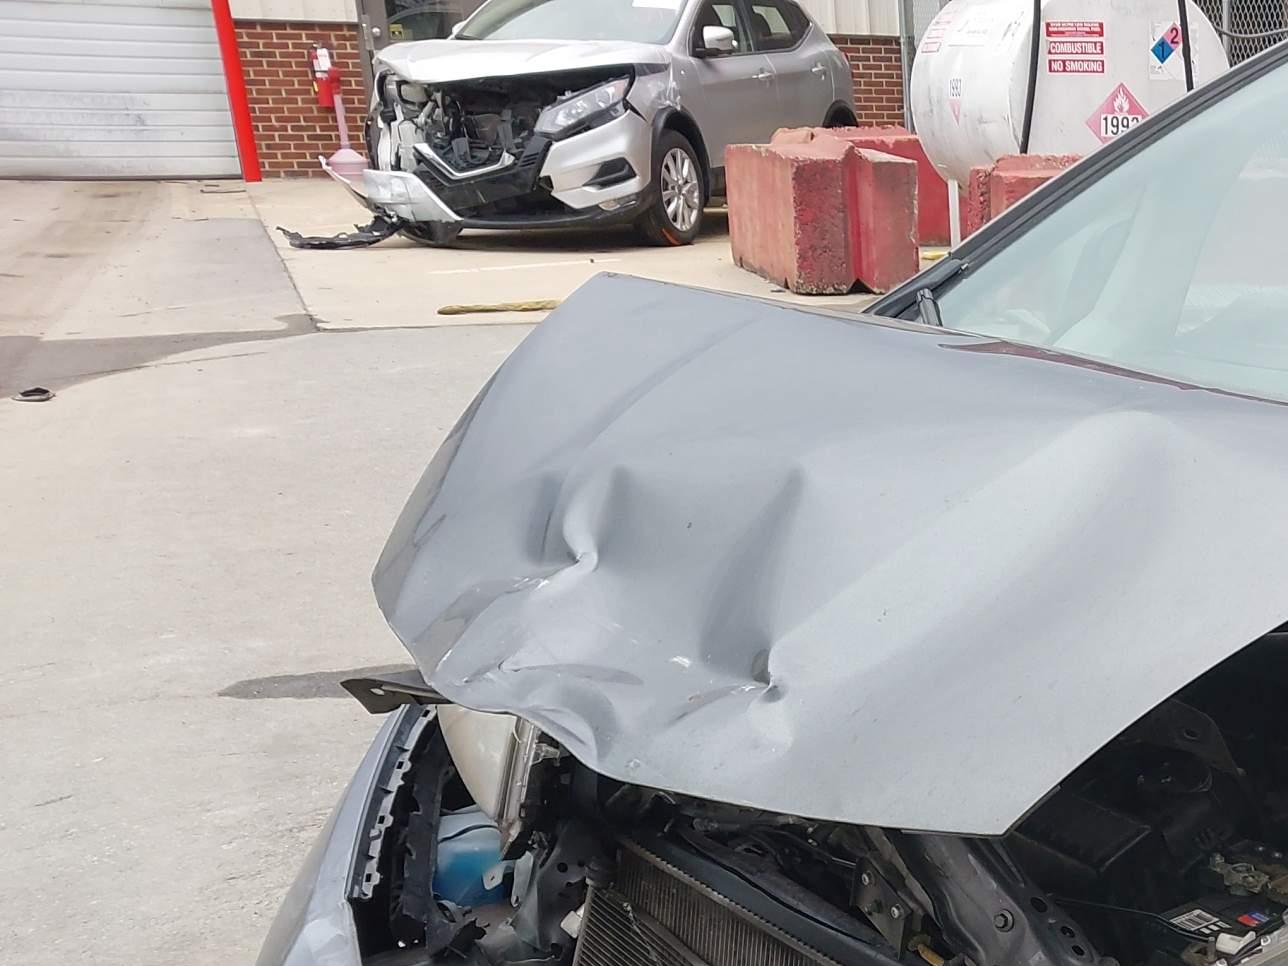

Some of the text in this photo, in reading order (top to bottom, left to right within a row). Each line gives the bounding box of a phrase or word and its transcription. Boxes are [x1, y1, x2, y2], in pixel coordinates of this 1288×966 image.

[1170, 27, 1179, 44] 2
[1049, 43, 1102, 54] COMBUSTIBLE
[1159, 41, 1165, 58] 1
[1051, 61, 1103, 72] NO SMOKING
